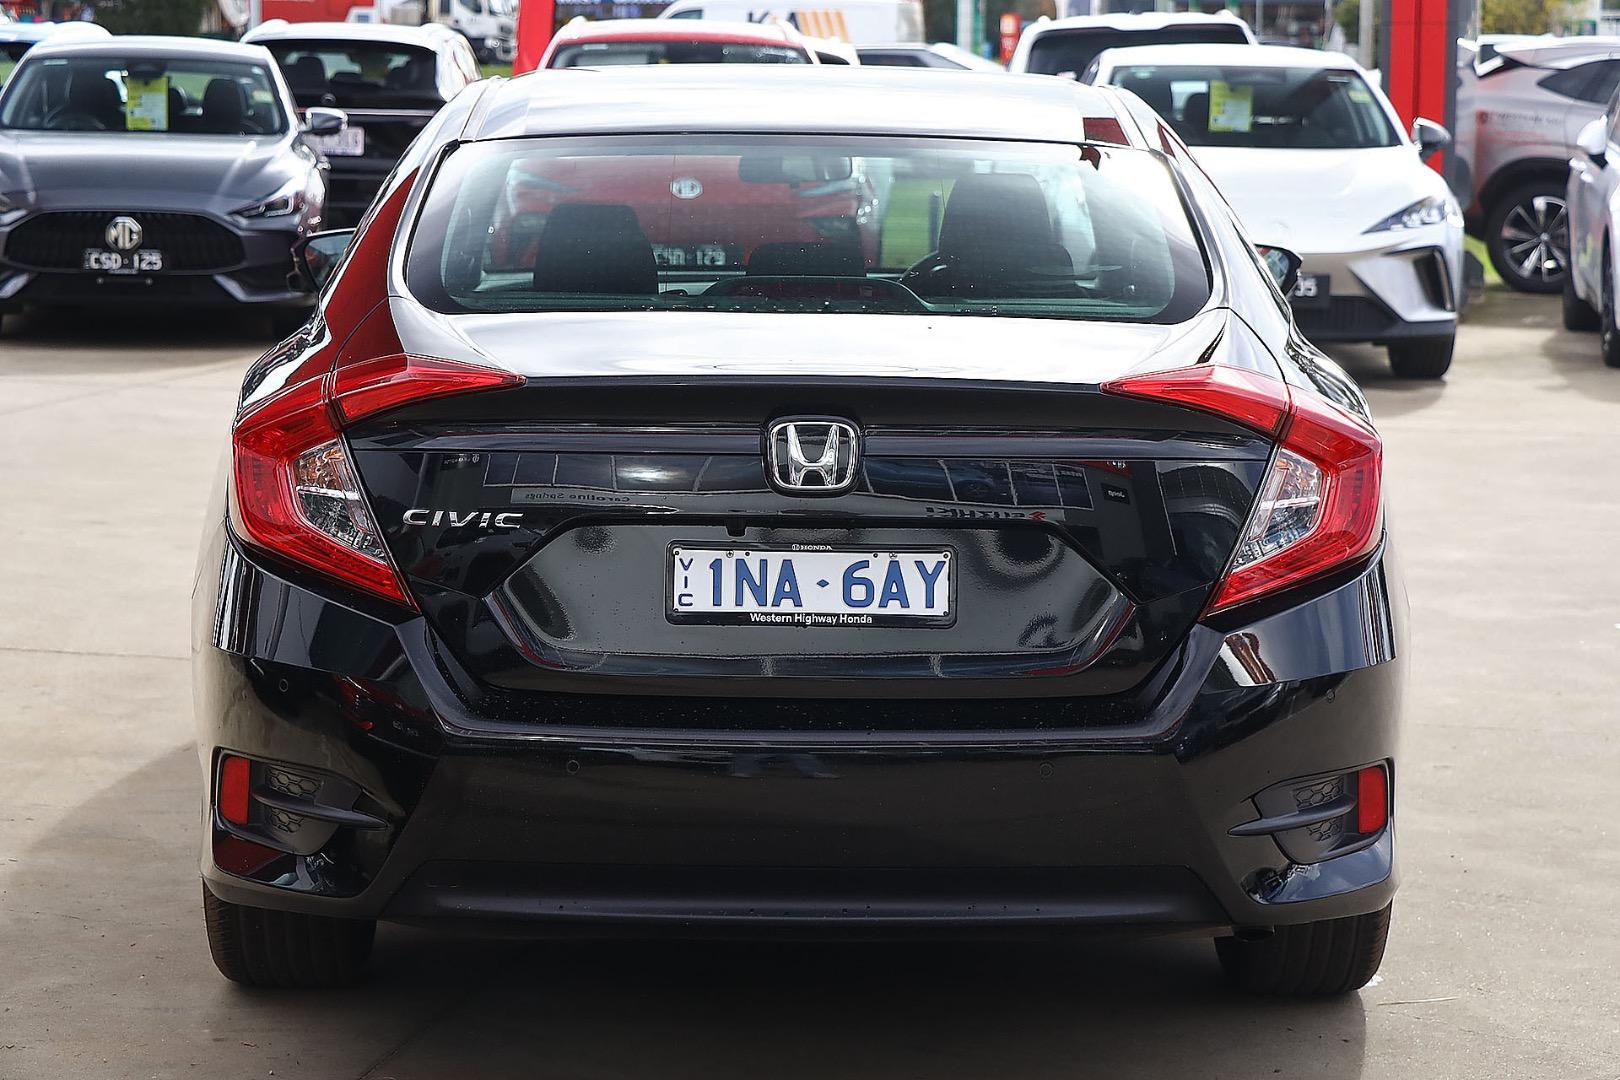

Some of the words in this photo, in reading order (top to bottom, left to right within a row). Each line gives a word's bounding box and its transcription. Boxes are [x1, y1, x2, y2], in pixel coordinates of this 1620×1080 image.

[402, 509, 524, 529] CIVIC
[750, 613, 792, 624] Western
[795, 613, 838, 626] Highway
[840, 614, 873, 624] Honda
